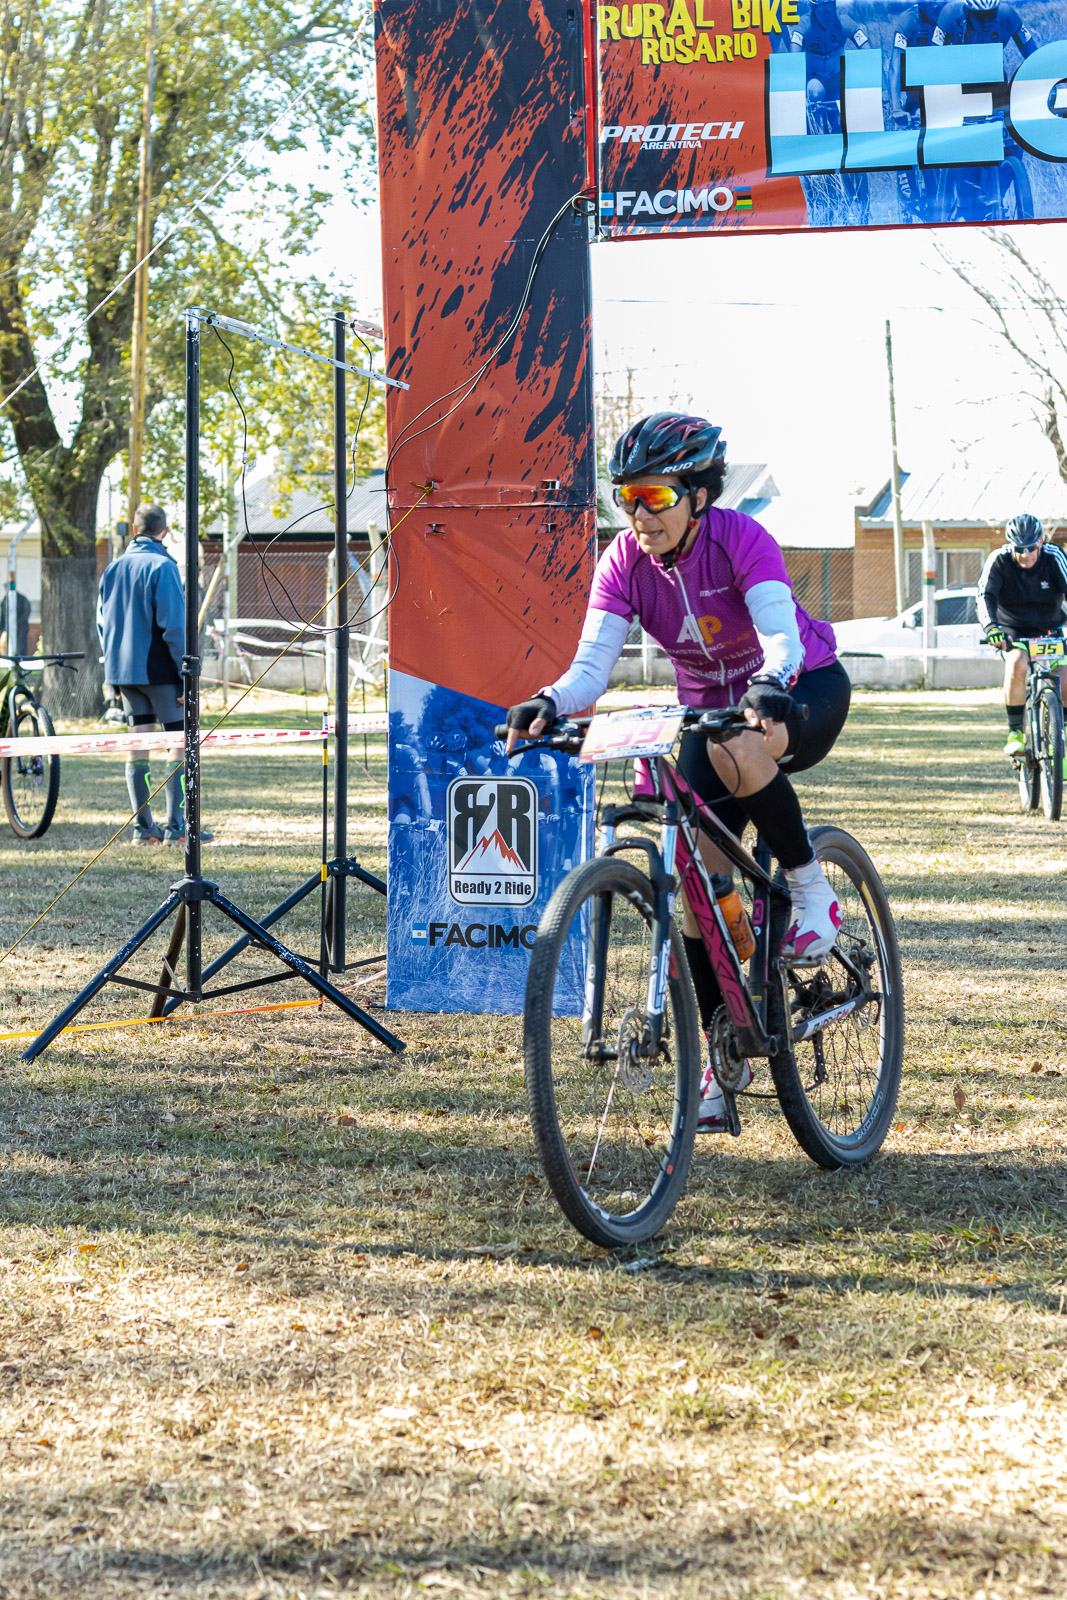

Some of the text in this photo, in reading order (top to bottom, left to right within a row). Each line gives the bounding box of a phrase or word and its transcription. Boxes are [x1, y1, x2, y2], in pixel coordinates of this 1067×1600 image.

[598, 0, 800, 40] RURAL BIKE
[642, 32, 758, 65] ROSARIO
[598, 121, 745, 143] PROTECH
[640, 141, 702, 150] ARGENTINA
[616, 186, 734, 216] FACIMO
[676, 614, 722, 645] AP
[1036, 643, 1058, 655] 35
[455, 880, 532, 896] Ready 2 Ride
